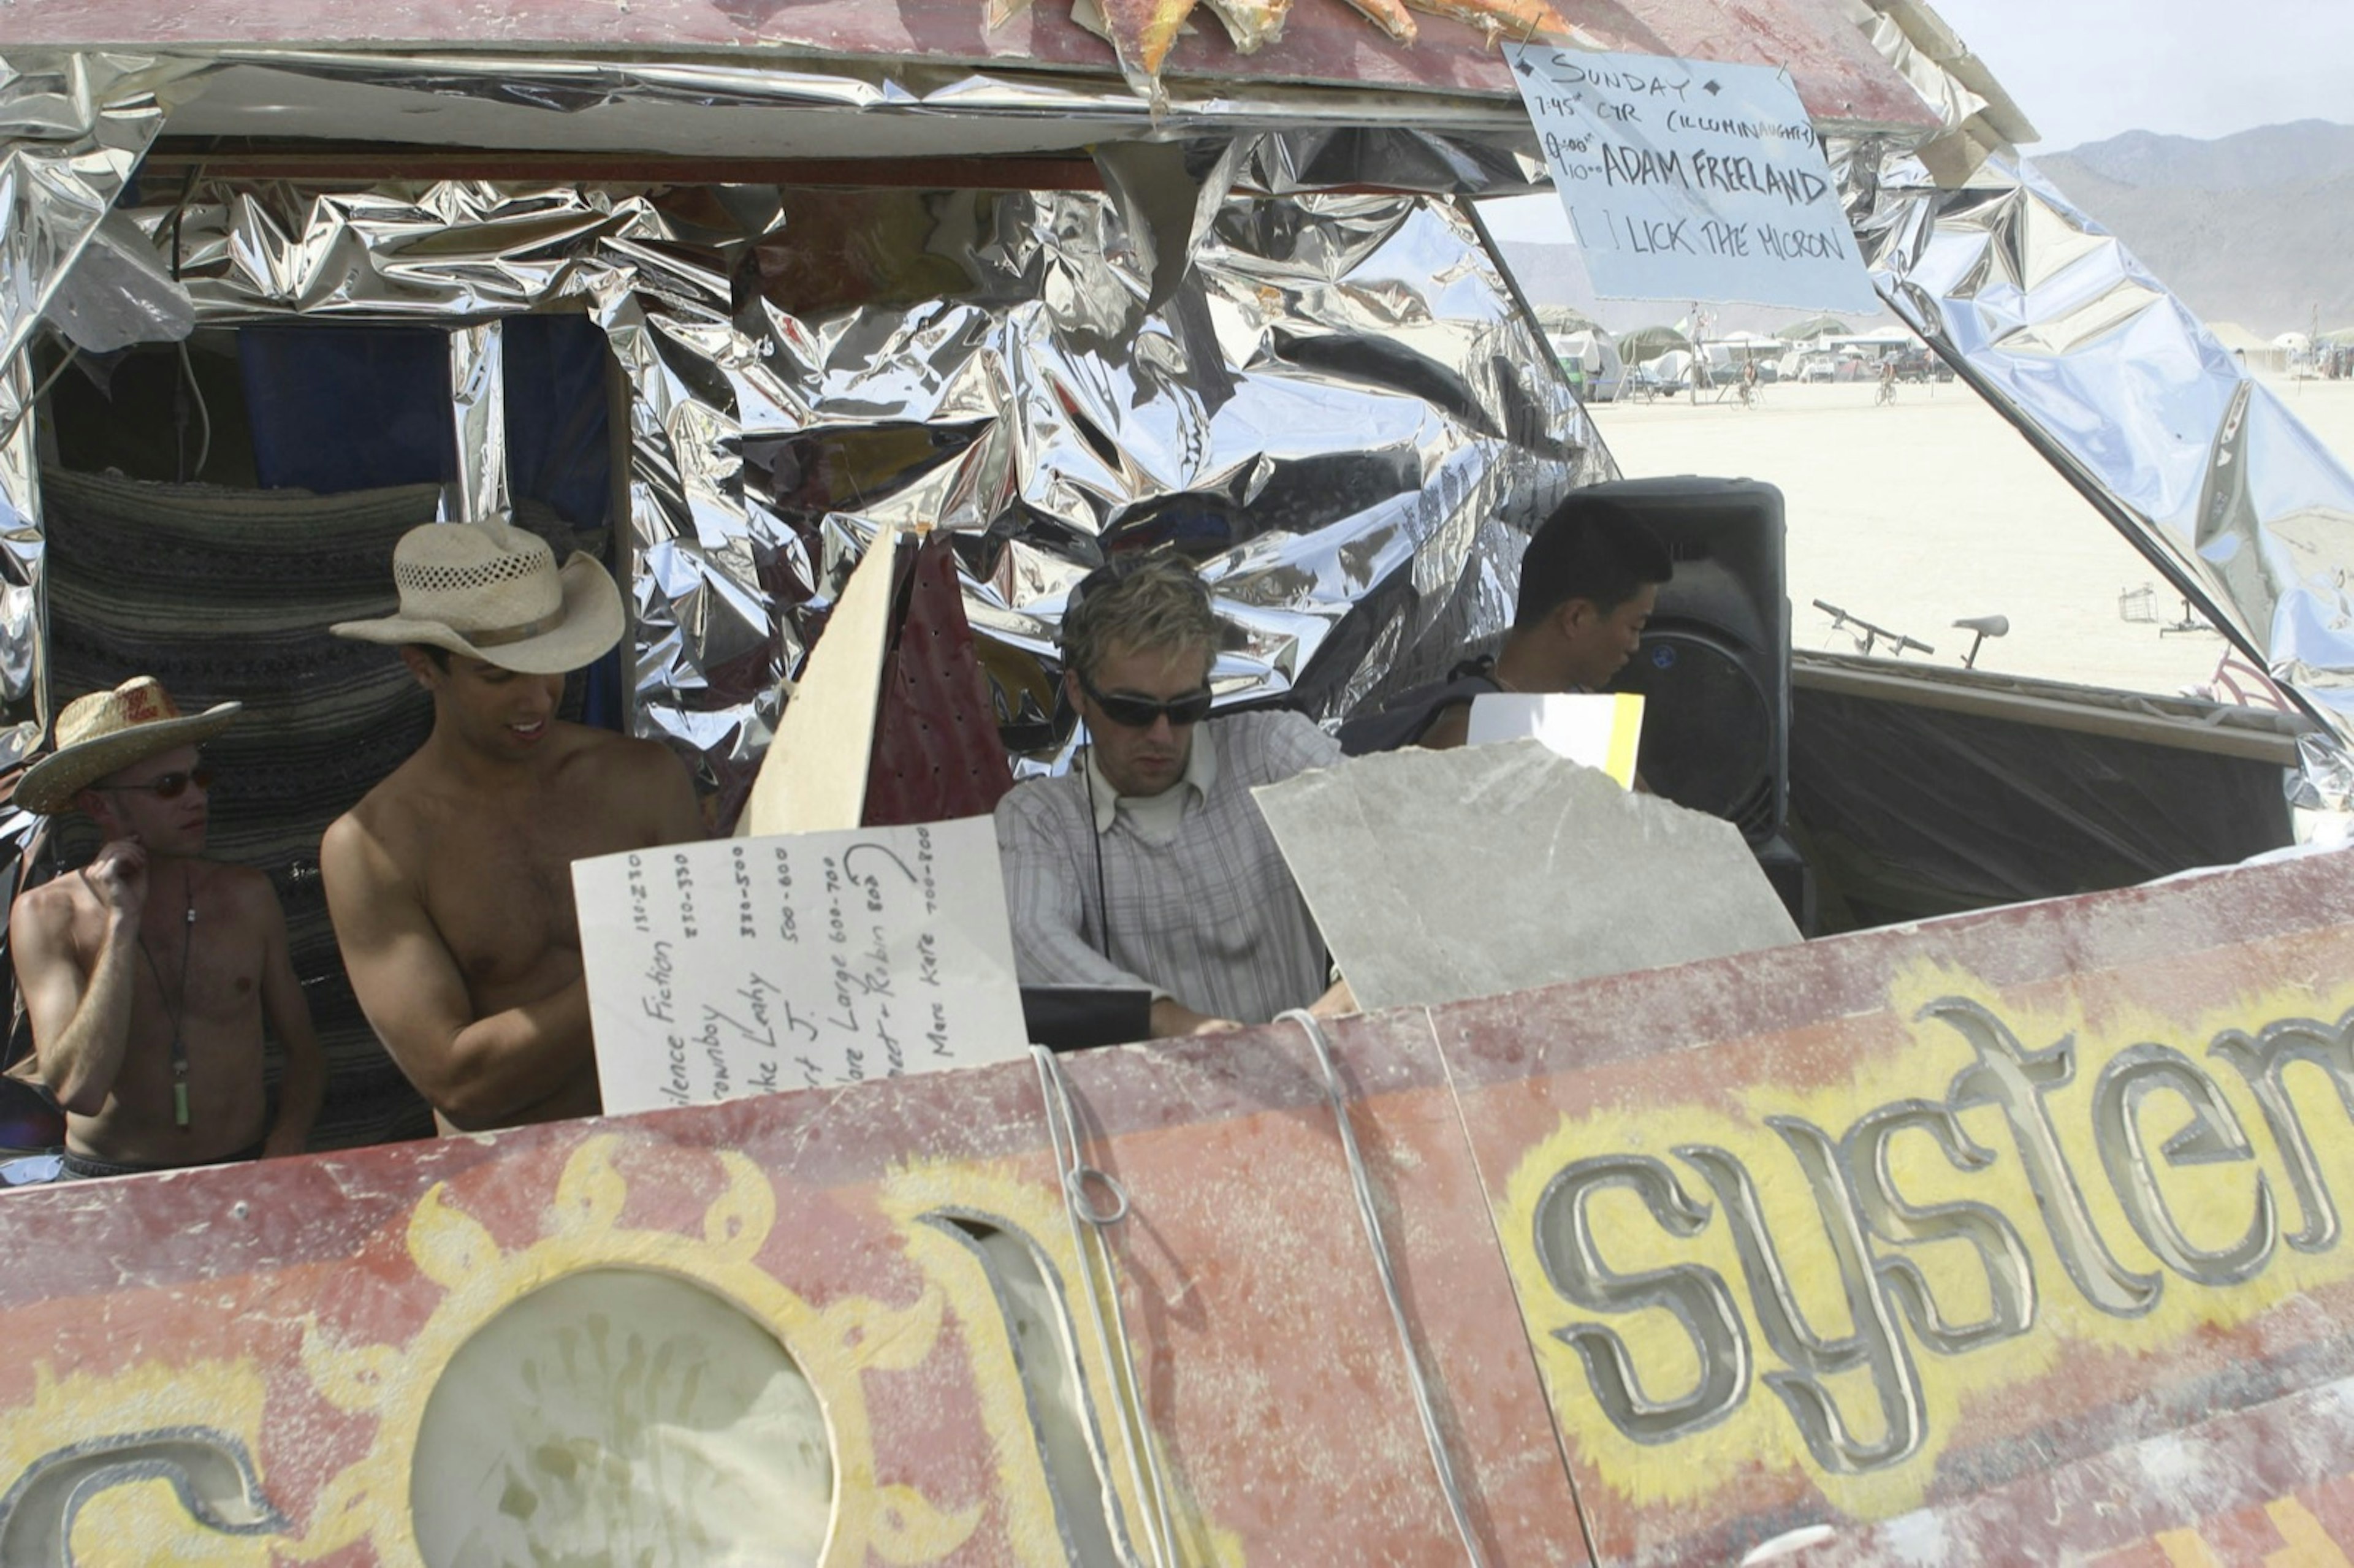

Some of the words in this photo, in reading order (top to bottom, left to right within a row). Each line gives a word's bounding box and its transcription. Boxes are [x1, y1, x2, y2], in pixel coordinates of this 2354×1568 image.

[1551, 53, 1691, 103] SUNDAY
[1601, 142, 1689, 191] ADAM
[1691, 148, 1828, 207] FREELAND
[1626, 216, 1696, 256] LICK
[1701, 218, 1750, 257] THE
[1756, 223, 1845, 261] MICRON
[642, 940, 676, 1023] Fiction
[828, 954, 869, 1032] Large
[863, 925, 894, 997] Robin
[917, 933, 942, 986] Kate
[736, 972, 781, 1048] Leahy
